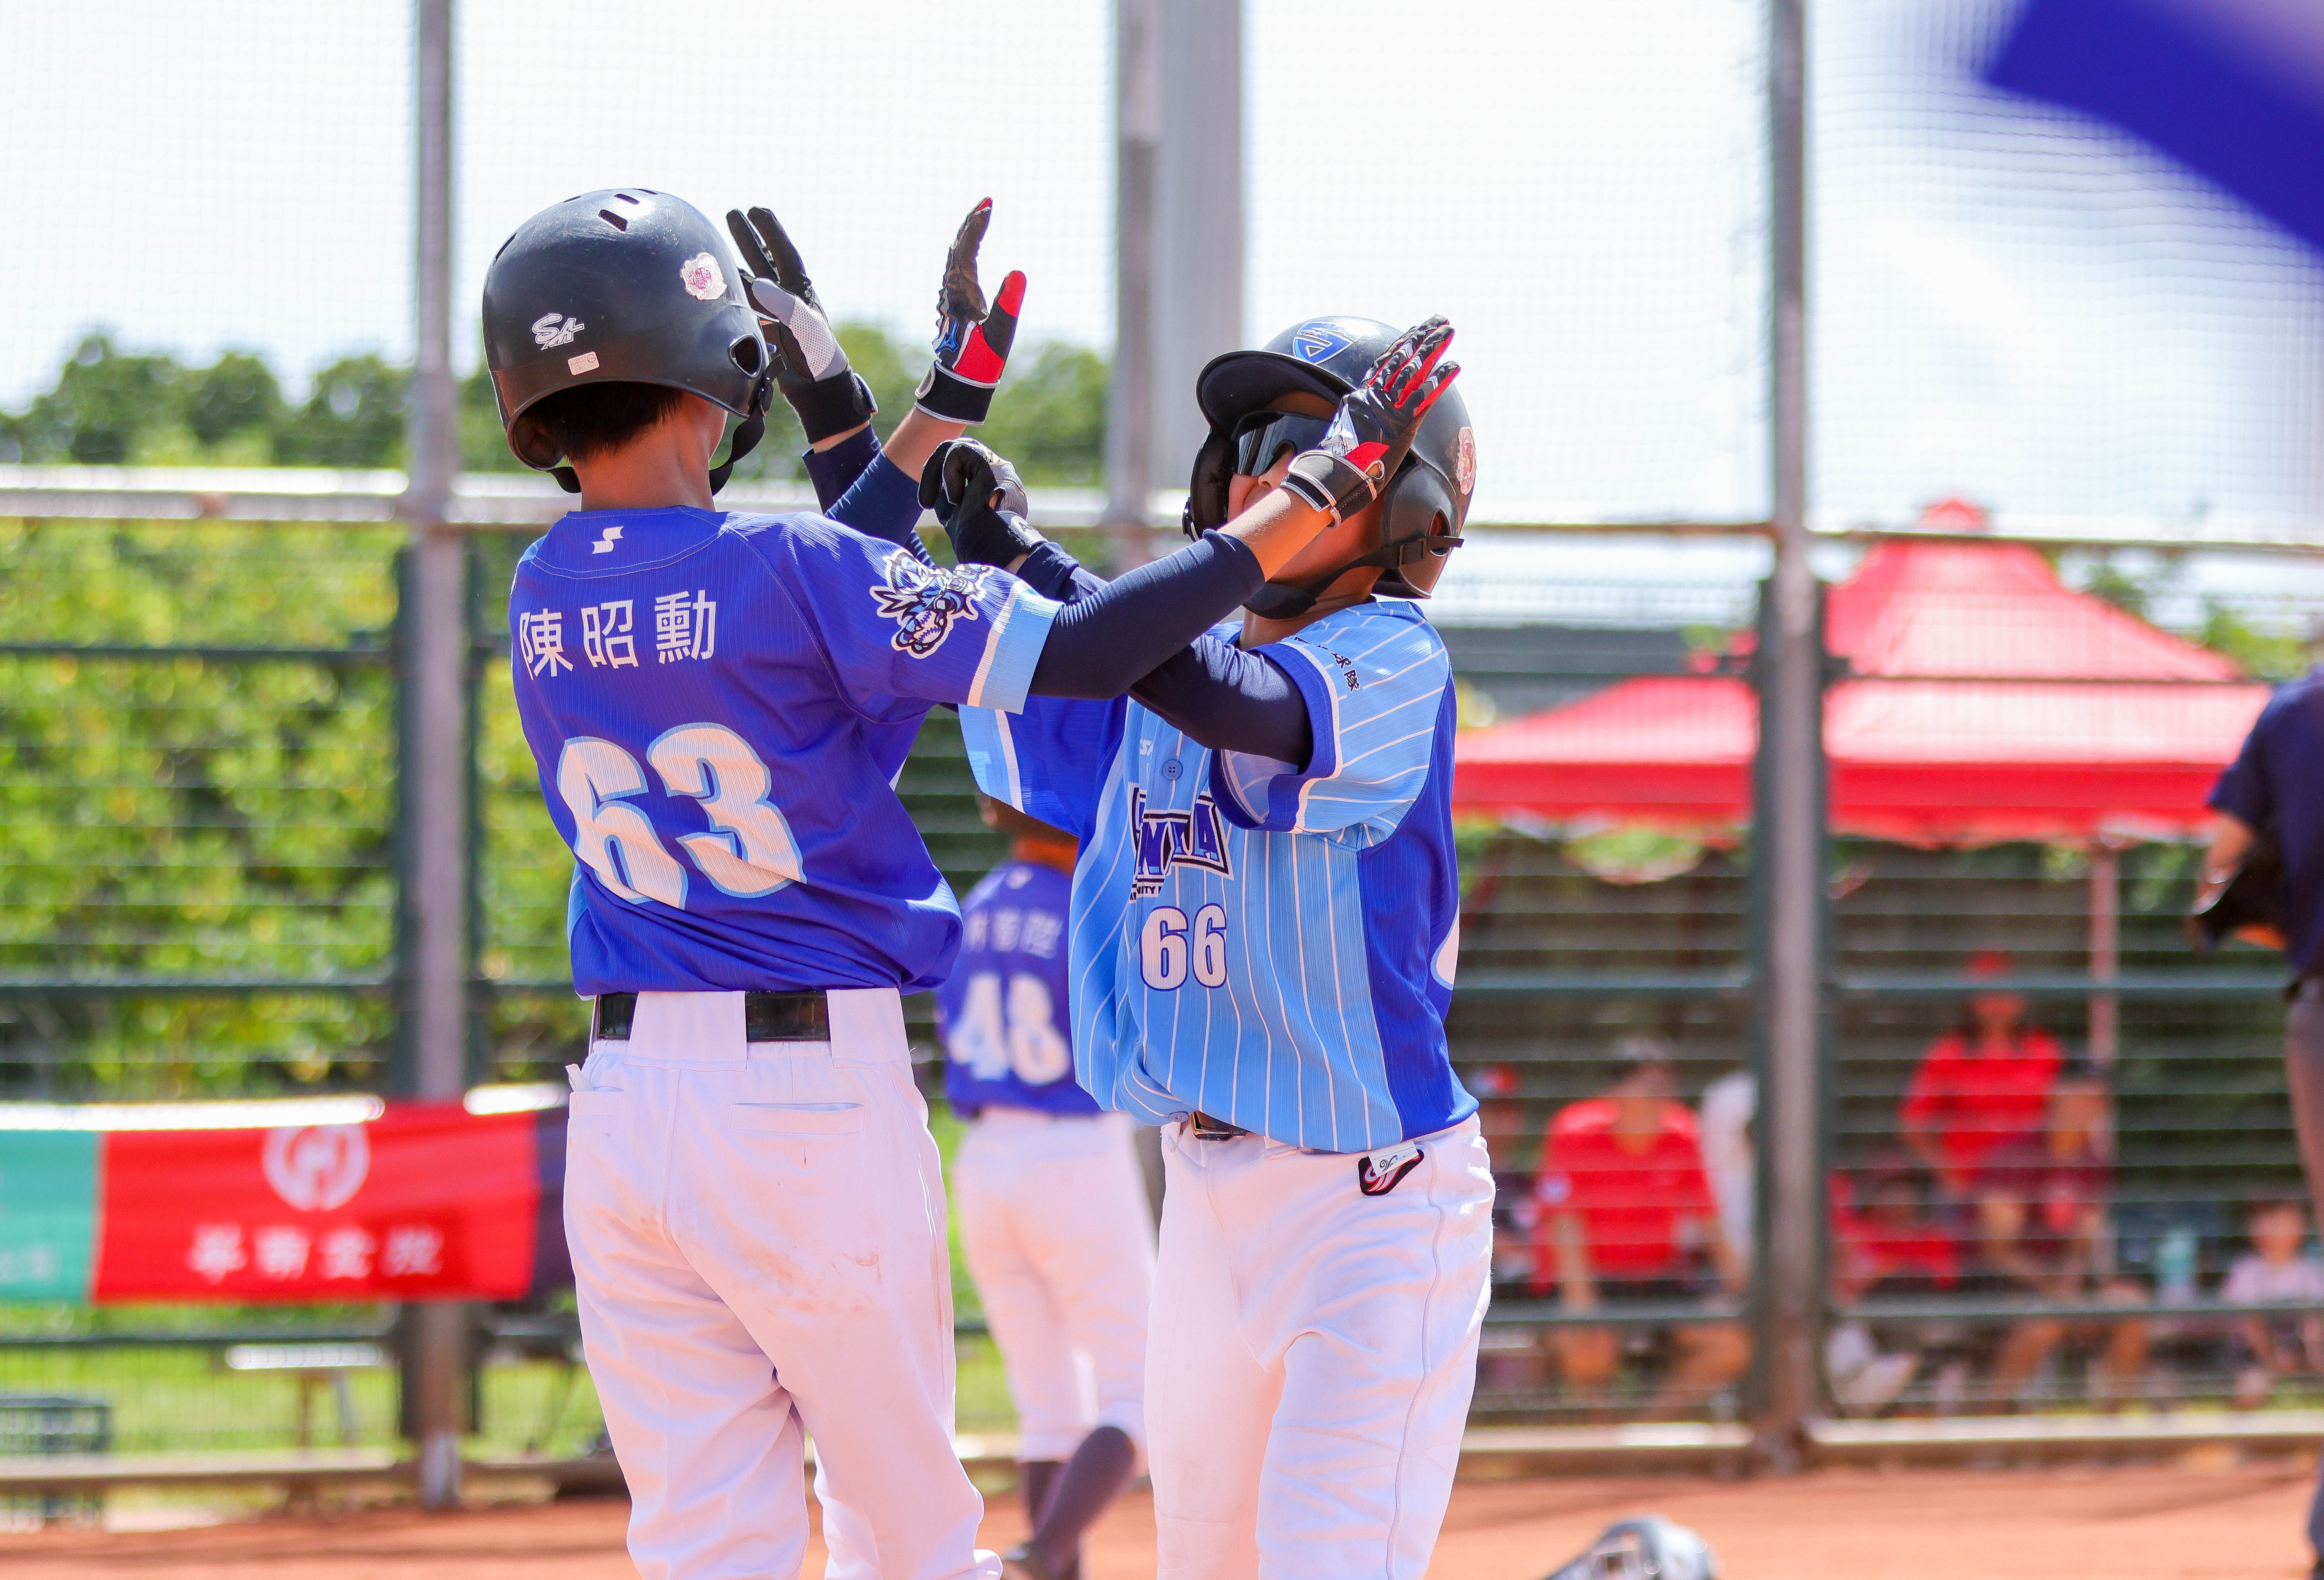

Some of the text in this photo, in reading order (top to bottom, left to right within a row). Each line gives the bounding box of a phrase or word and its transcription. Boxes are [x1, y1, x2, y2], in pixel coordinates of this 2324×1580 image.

[520, 590, 716, 680] 陳昭勳
[557, 722, 807, 910] 63
[1140, 903, 1227, 991] 66
[948, 972, 1071, 1084] 48
